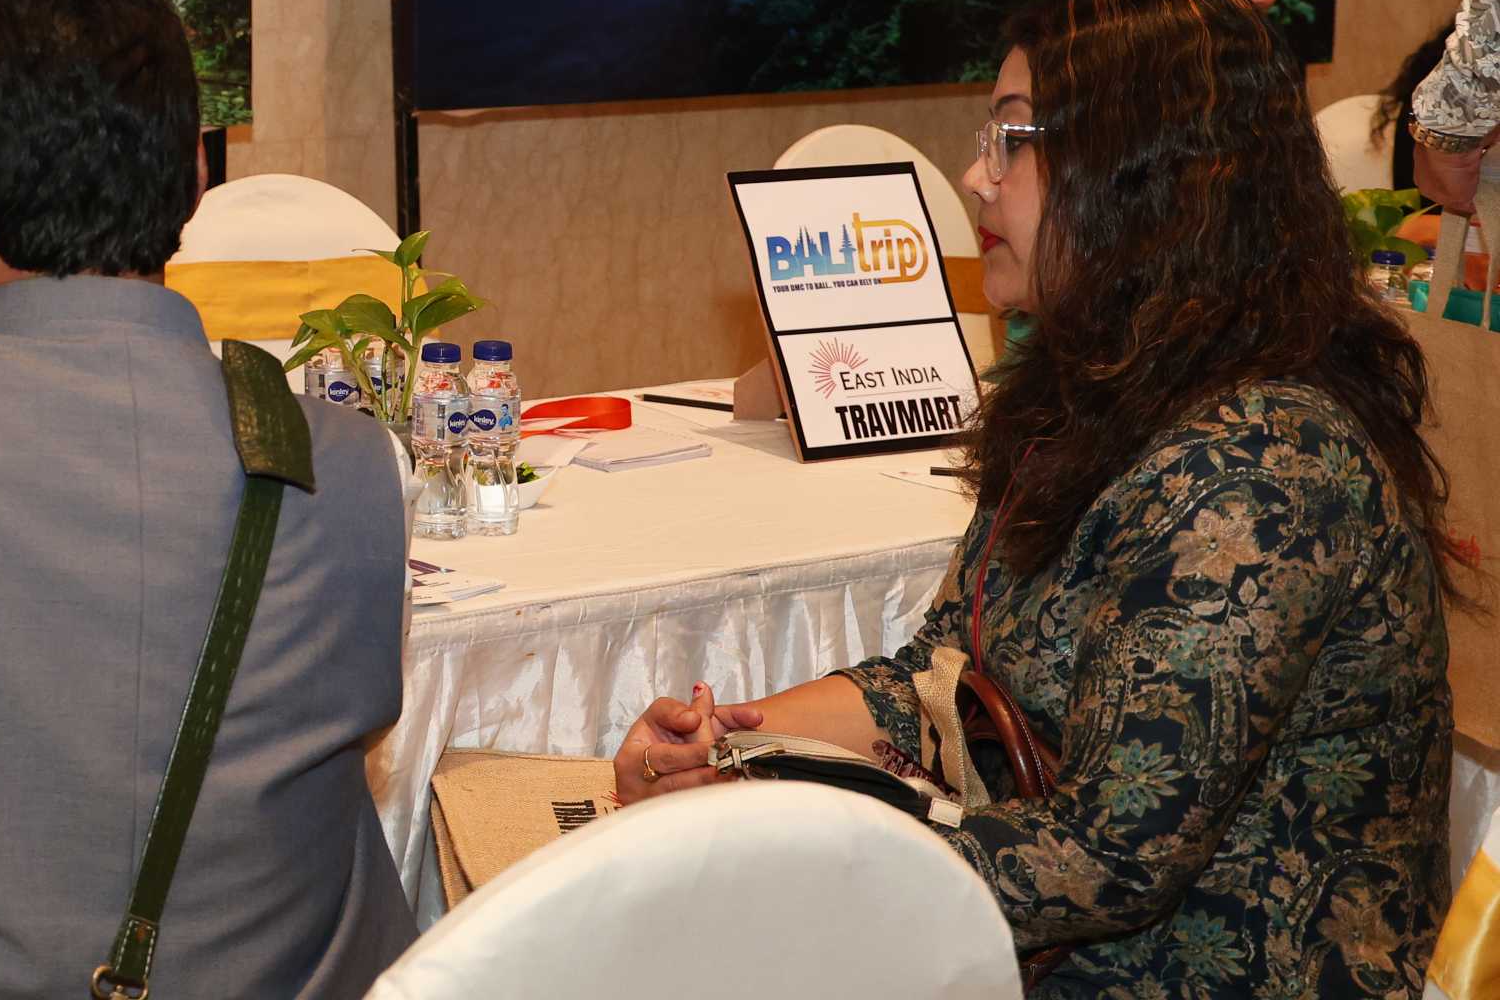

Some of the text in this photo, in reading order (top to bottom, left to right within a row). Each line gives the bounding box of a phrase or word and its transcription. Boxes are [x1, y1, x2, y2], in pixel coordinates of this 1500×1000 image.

[839, 366, 942, 391] EAST INDIA
[449, 420, 466, 428] kinle
[835, 395, 964, 440] TRAVMART
